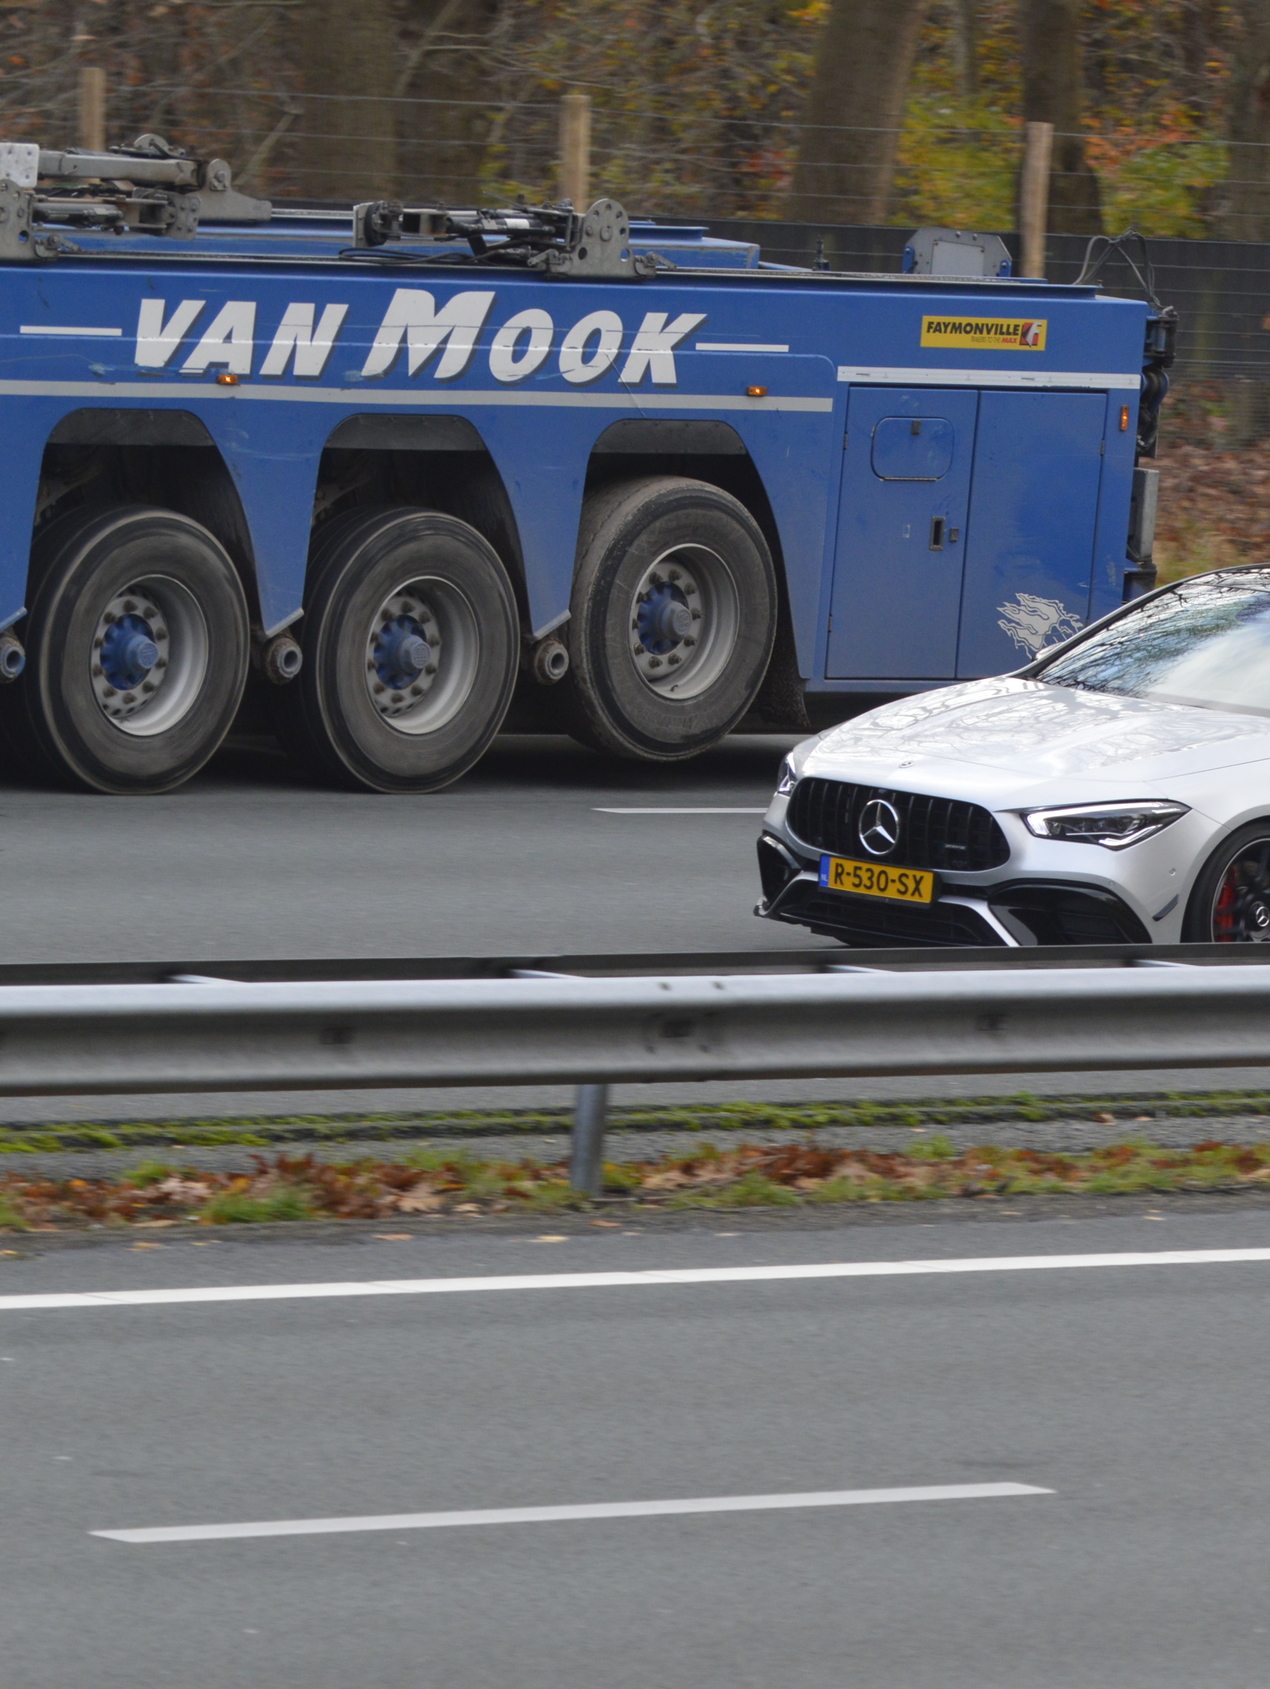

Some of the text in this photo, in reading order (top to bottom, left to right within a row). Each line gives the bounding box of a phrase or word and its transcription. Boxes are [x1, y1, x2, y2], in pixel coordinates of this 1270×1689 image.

[134, 288, 708, 386] VAN MOOK
[926, 321, 1020, 337] FAYMONVILLE
[820, 873, 828, 882] NL
[834, 862, 925, 898] R-530-SX
